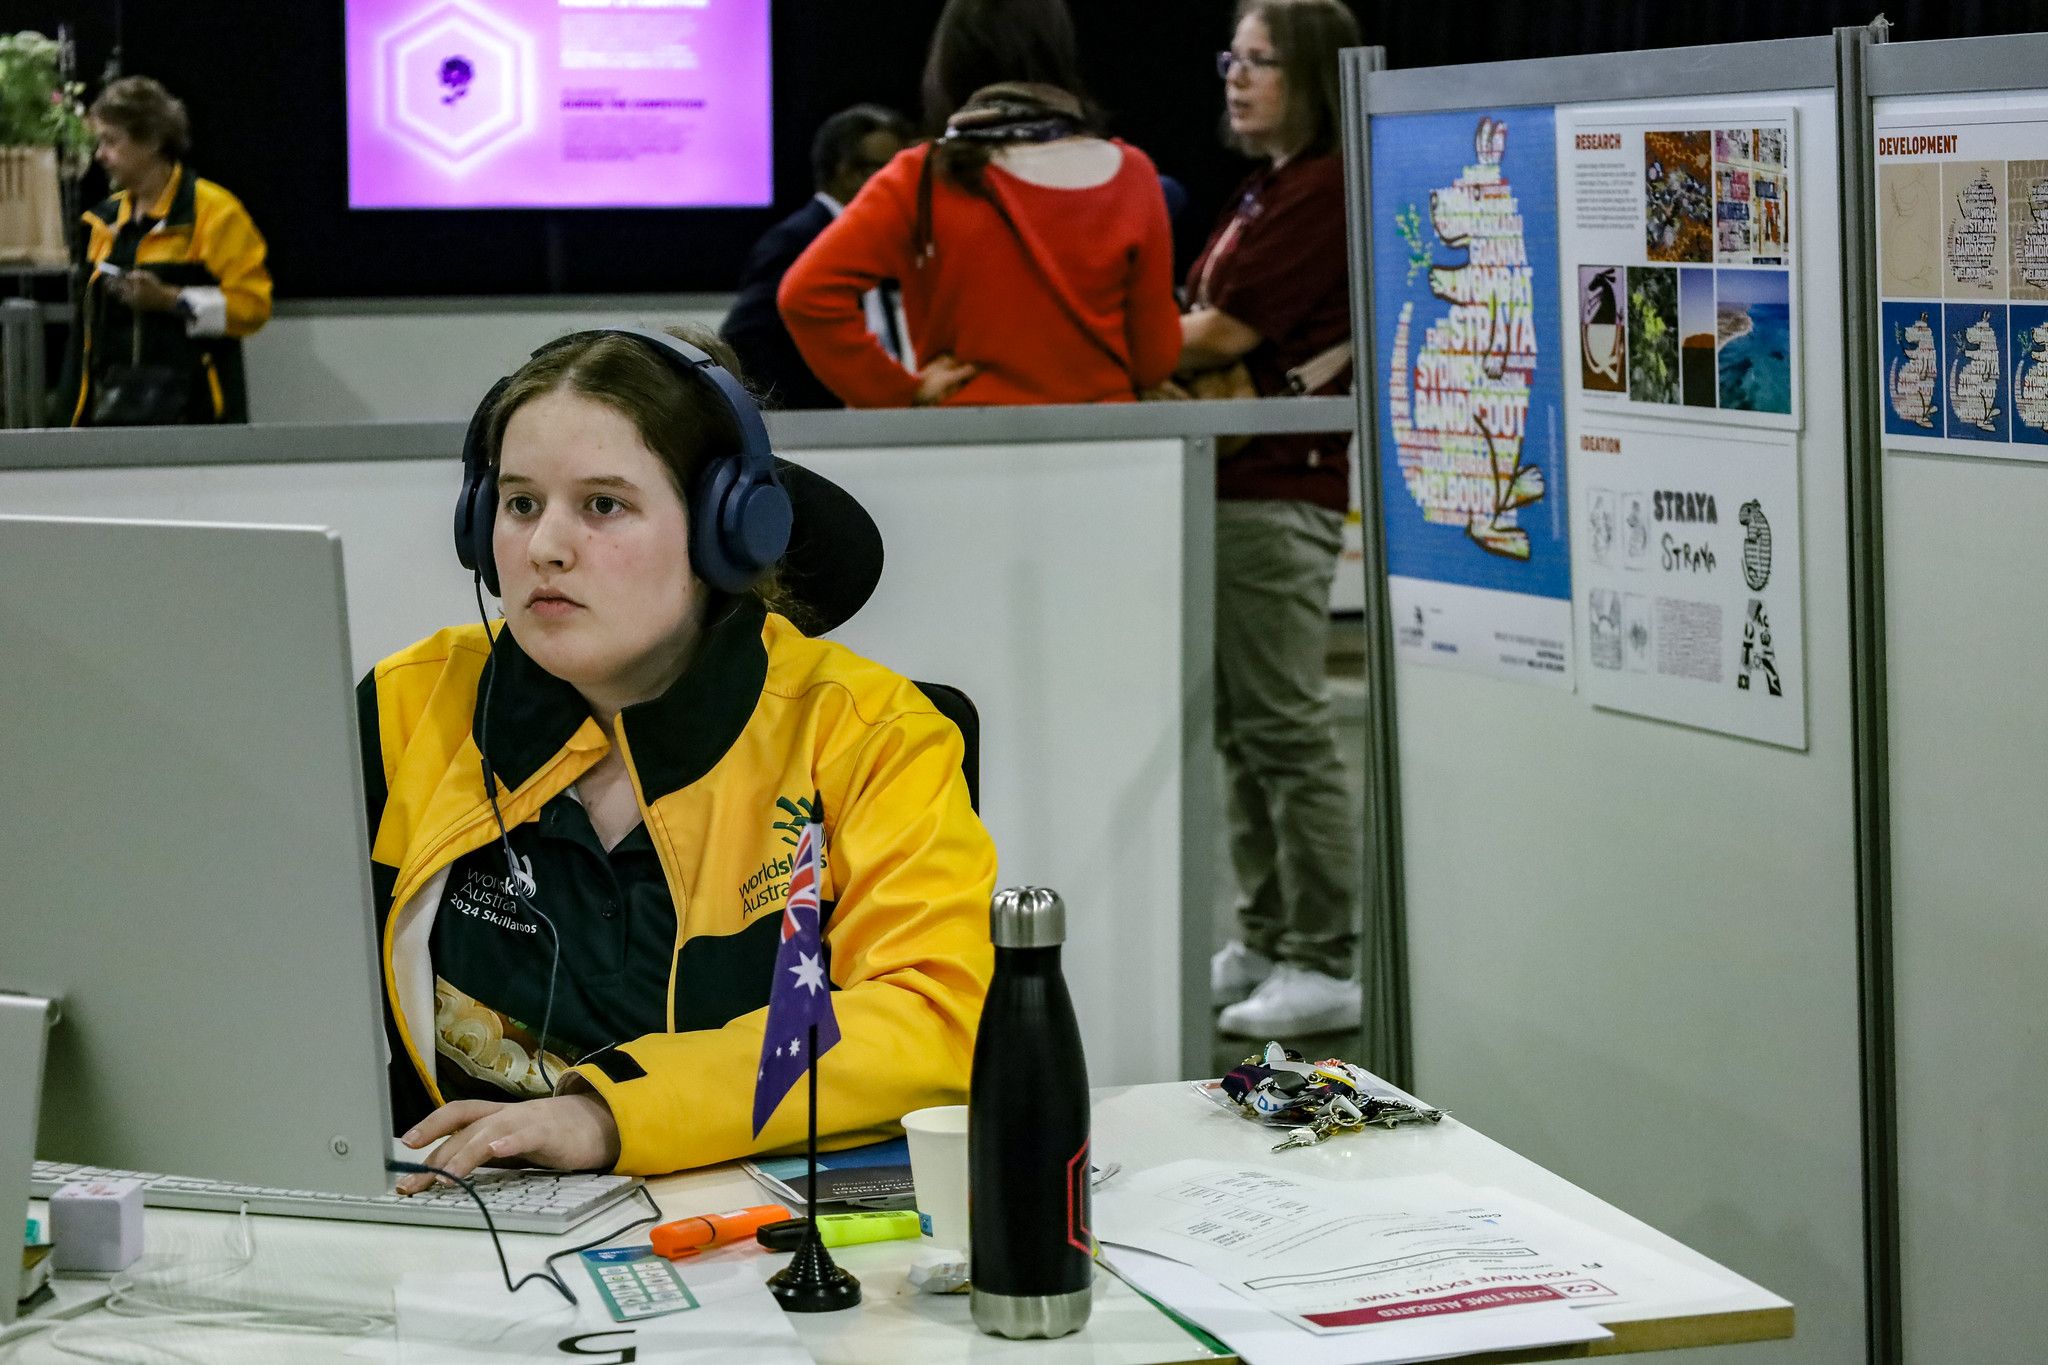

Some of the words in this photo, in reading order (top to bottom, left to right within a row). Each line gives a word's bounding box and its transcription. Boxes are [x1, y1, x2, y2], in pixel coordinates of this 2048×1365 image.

[1575, 133, 1621, 150] RESEARCH
[1879, 134, 1958, 156] DEVELOPMENT
[1448, 304, 1538, 353] STRAYA
[1653, 489, 1718, 524] STRAYA
[450, 893, 480, 918] 2024
[1475, 1274, 1529, 1287] HAVE
[1534, 1269, 1579, 1283] YOU
[1407, 1278, 1472, 1297] EXTRA
[1500, 1288, 1554, 1303] EXTRA
[1561, 1282, 1599, 1296] C2
[1352, 1291, 1402, 1305] TIME
[1461, 1293, 1499, 1308] TIME
[1377, 1299, 1462, 1318] ALLOCATED
